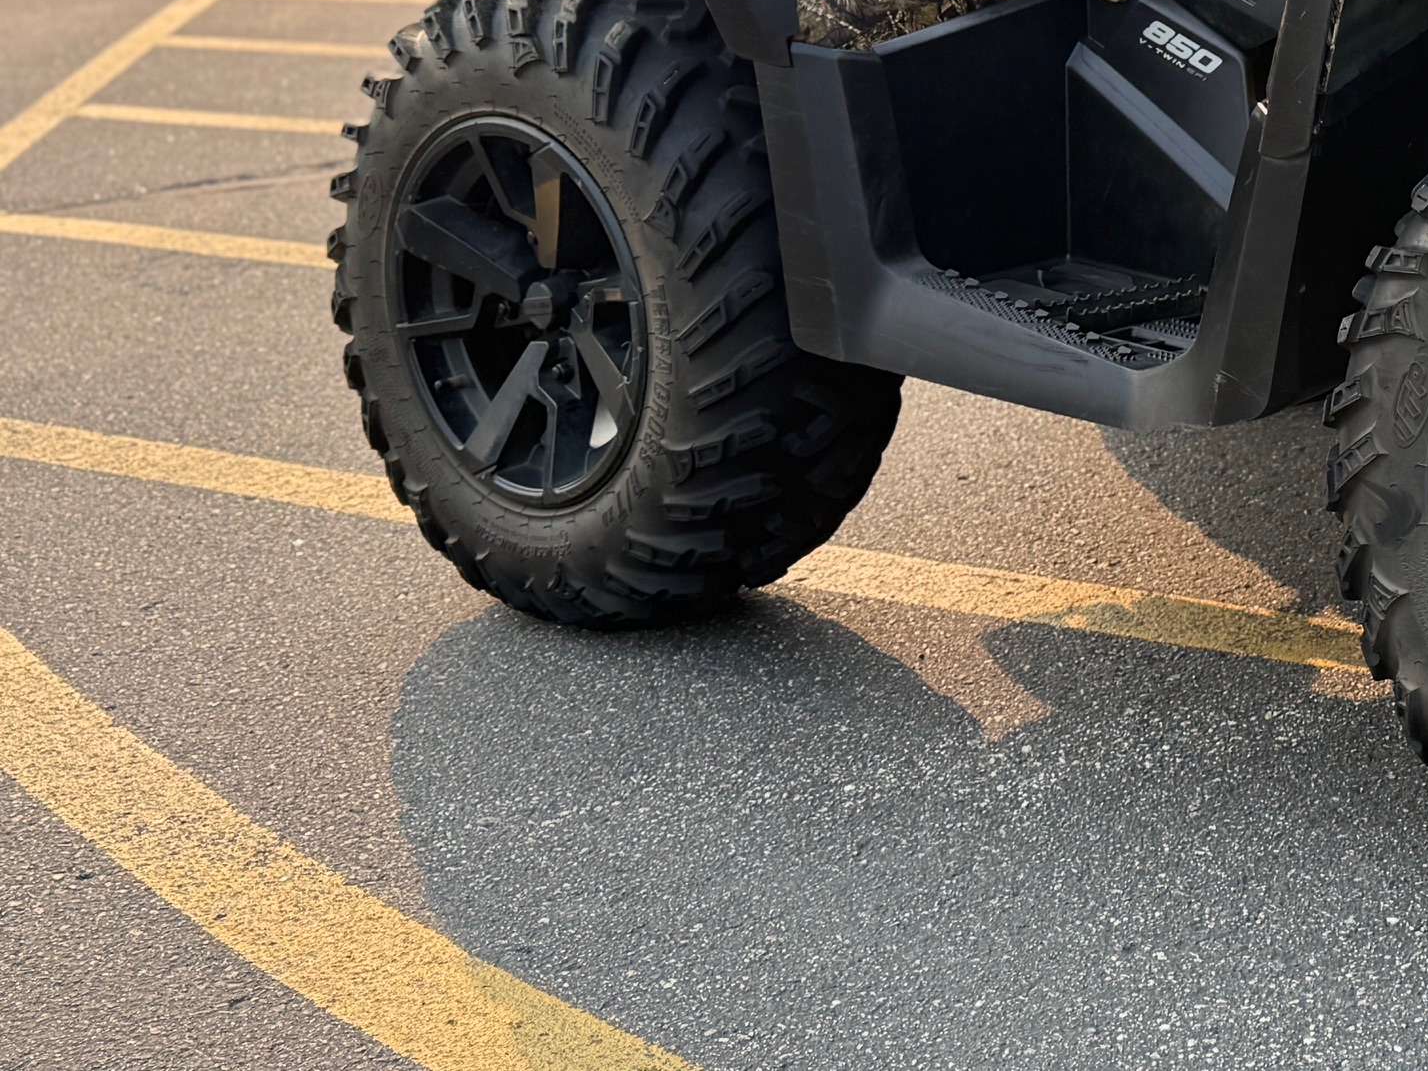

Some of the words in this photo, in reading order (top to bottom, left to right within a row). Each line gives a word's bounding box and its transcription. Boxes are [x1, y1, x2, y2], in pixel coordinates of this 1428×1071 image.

[1139, 37, 1185, 69] V-TWIN
[1142, 20, 1223, 74] 850
[1393, 361, 1428, 441] ITP
